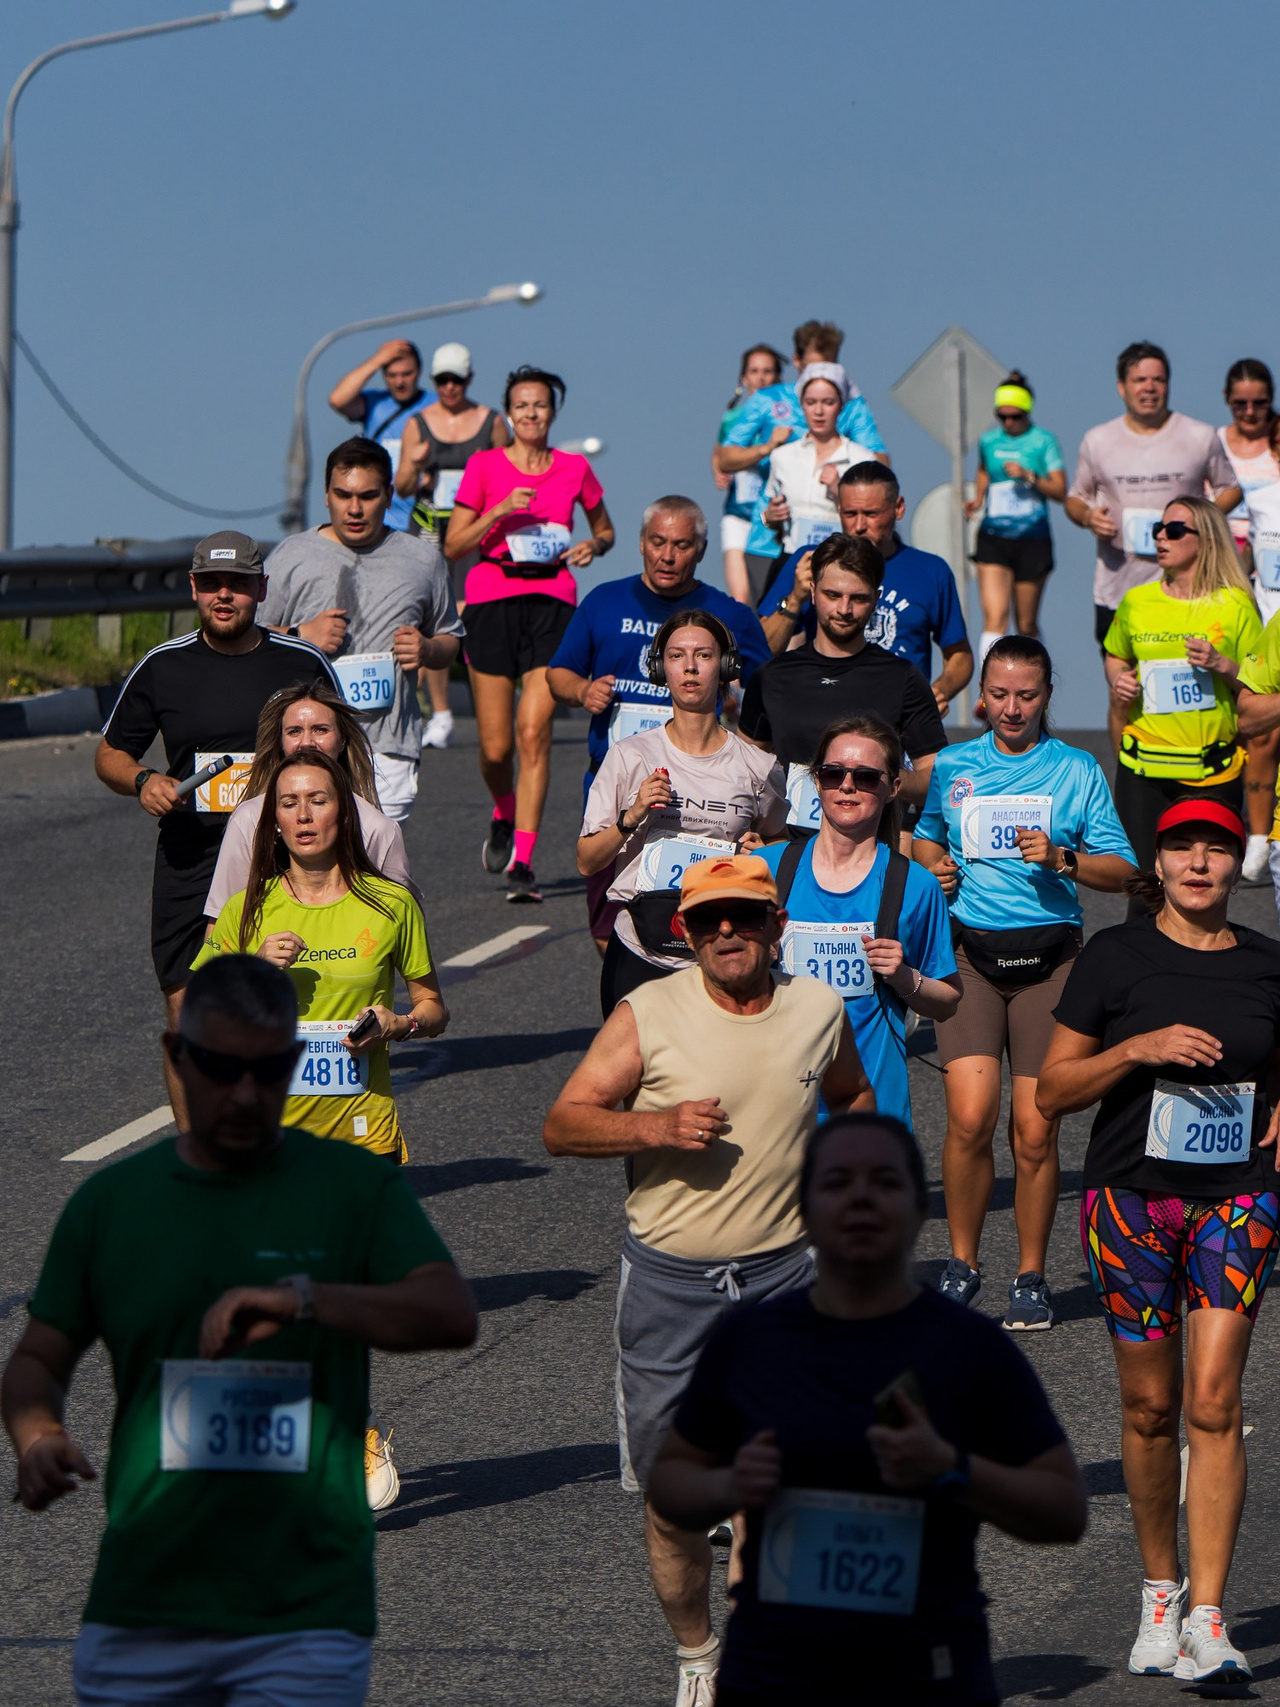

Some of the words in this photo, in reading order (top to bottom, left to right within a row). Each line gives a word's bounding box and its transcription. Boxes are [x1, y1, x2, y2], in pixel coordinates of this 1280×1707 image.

[621, 618, 663, 640] BAU
[363, 668, 377, 678] ЛЕВ
[350, 679, 390, 702] 3370
[612, 679, 670, 698] UNIVERSI
[1172, 683, 1203, 705] 169
[666, 796, 743, 816] ENET
[992, 811, 1041, 821] АНАСТАСИЯ
[991, 825, 1042, 849] 39
[296, 947, 357, 962] Zeneca
[814, 942, 857, 955] ТАТЬЯНА
[807, 959, 865, 987] 3133
[997, 957, 1041, 968] Reebok
[308, 1041, 348, 1053] ЕВГЕНИ
[302, 1058, 360, 1086] 4818
[1200, 1105, 1235, 1119] ОКСАНА
[1184, 1122, 1243, 1153] 2098
[208, 1413, 296, 1457] 3189
[817, 1549, 905, 1599] 1622
